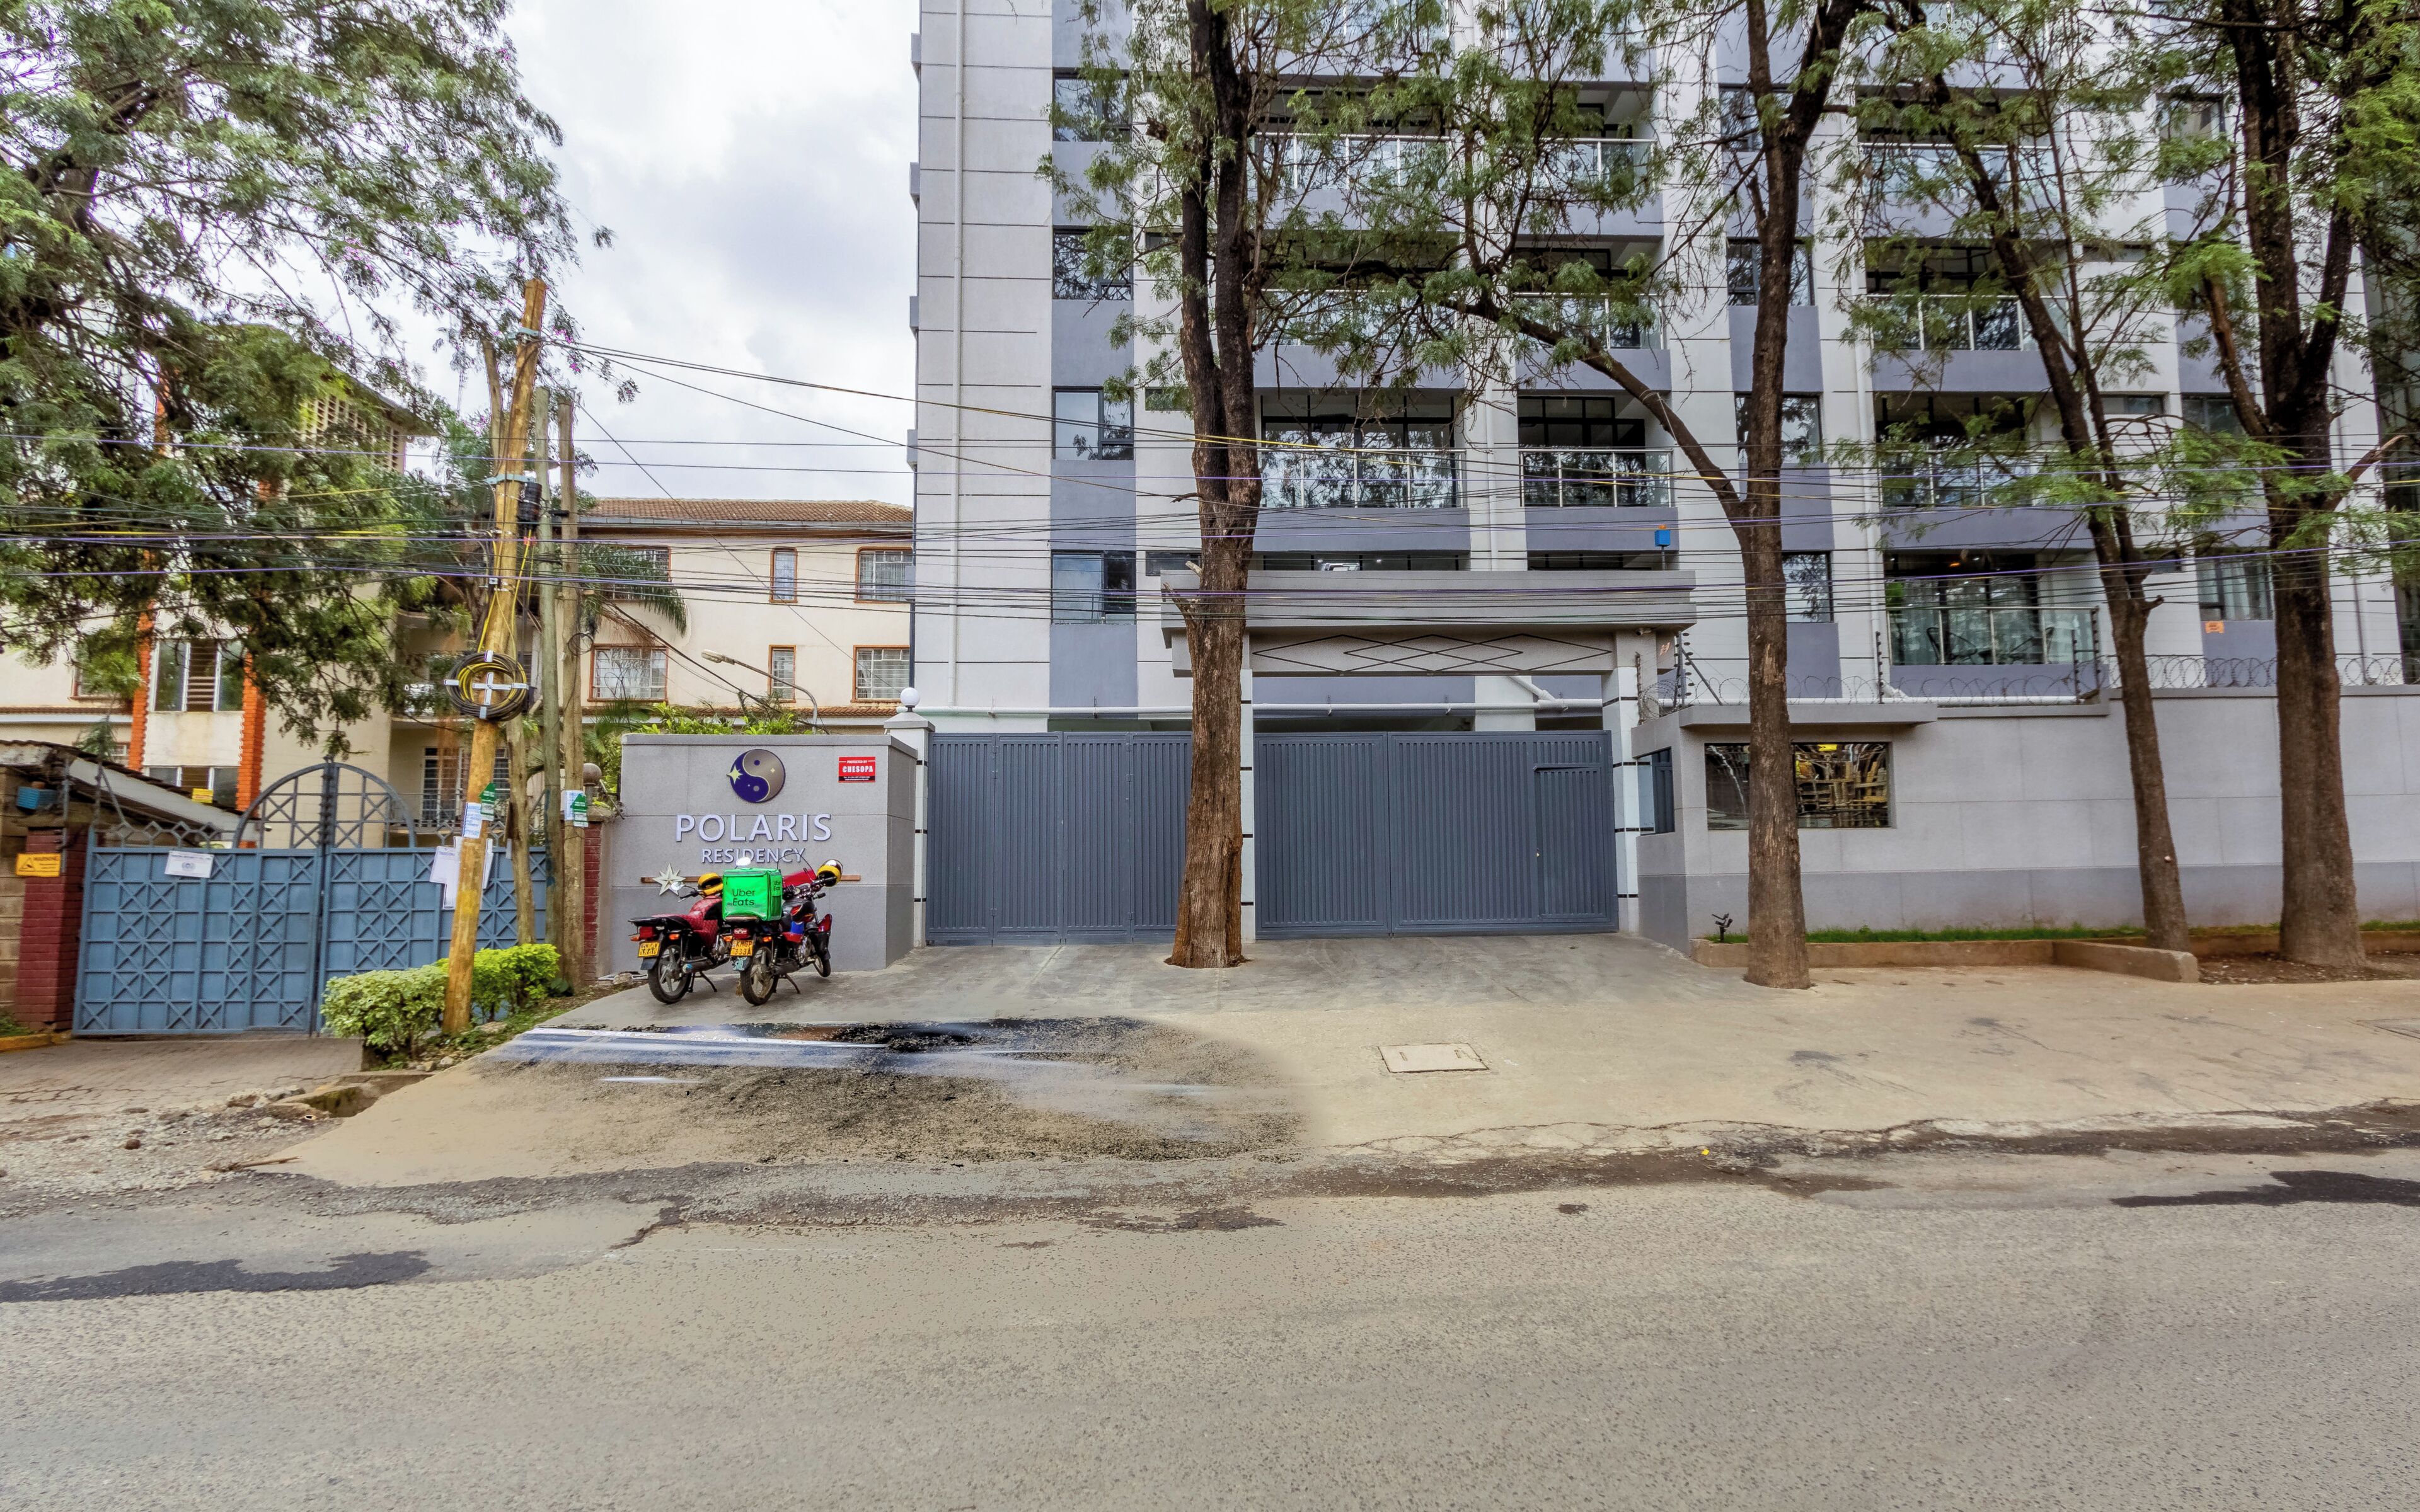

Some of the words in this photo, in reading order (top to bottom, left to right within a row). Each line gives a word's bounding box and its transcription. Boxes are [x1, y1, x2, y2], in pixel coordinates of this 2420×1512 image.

[676, 813, 832, 842] POLARIS
[701, 847, 805, 863] RESIDENCY
[732, 888, 756, 897] Uber
[732, 898, 755, 906] Eats
